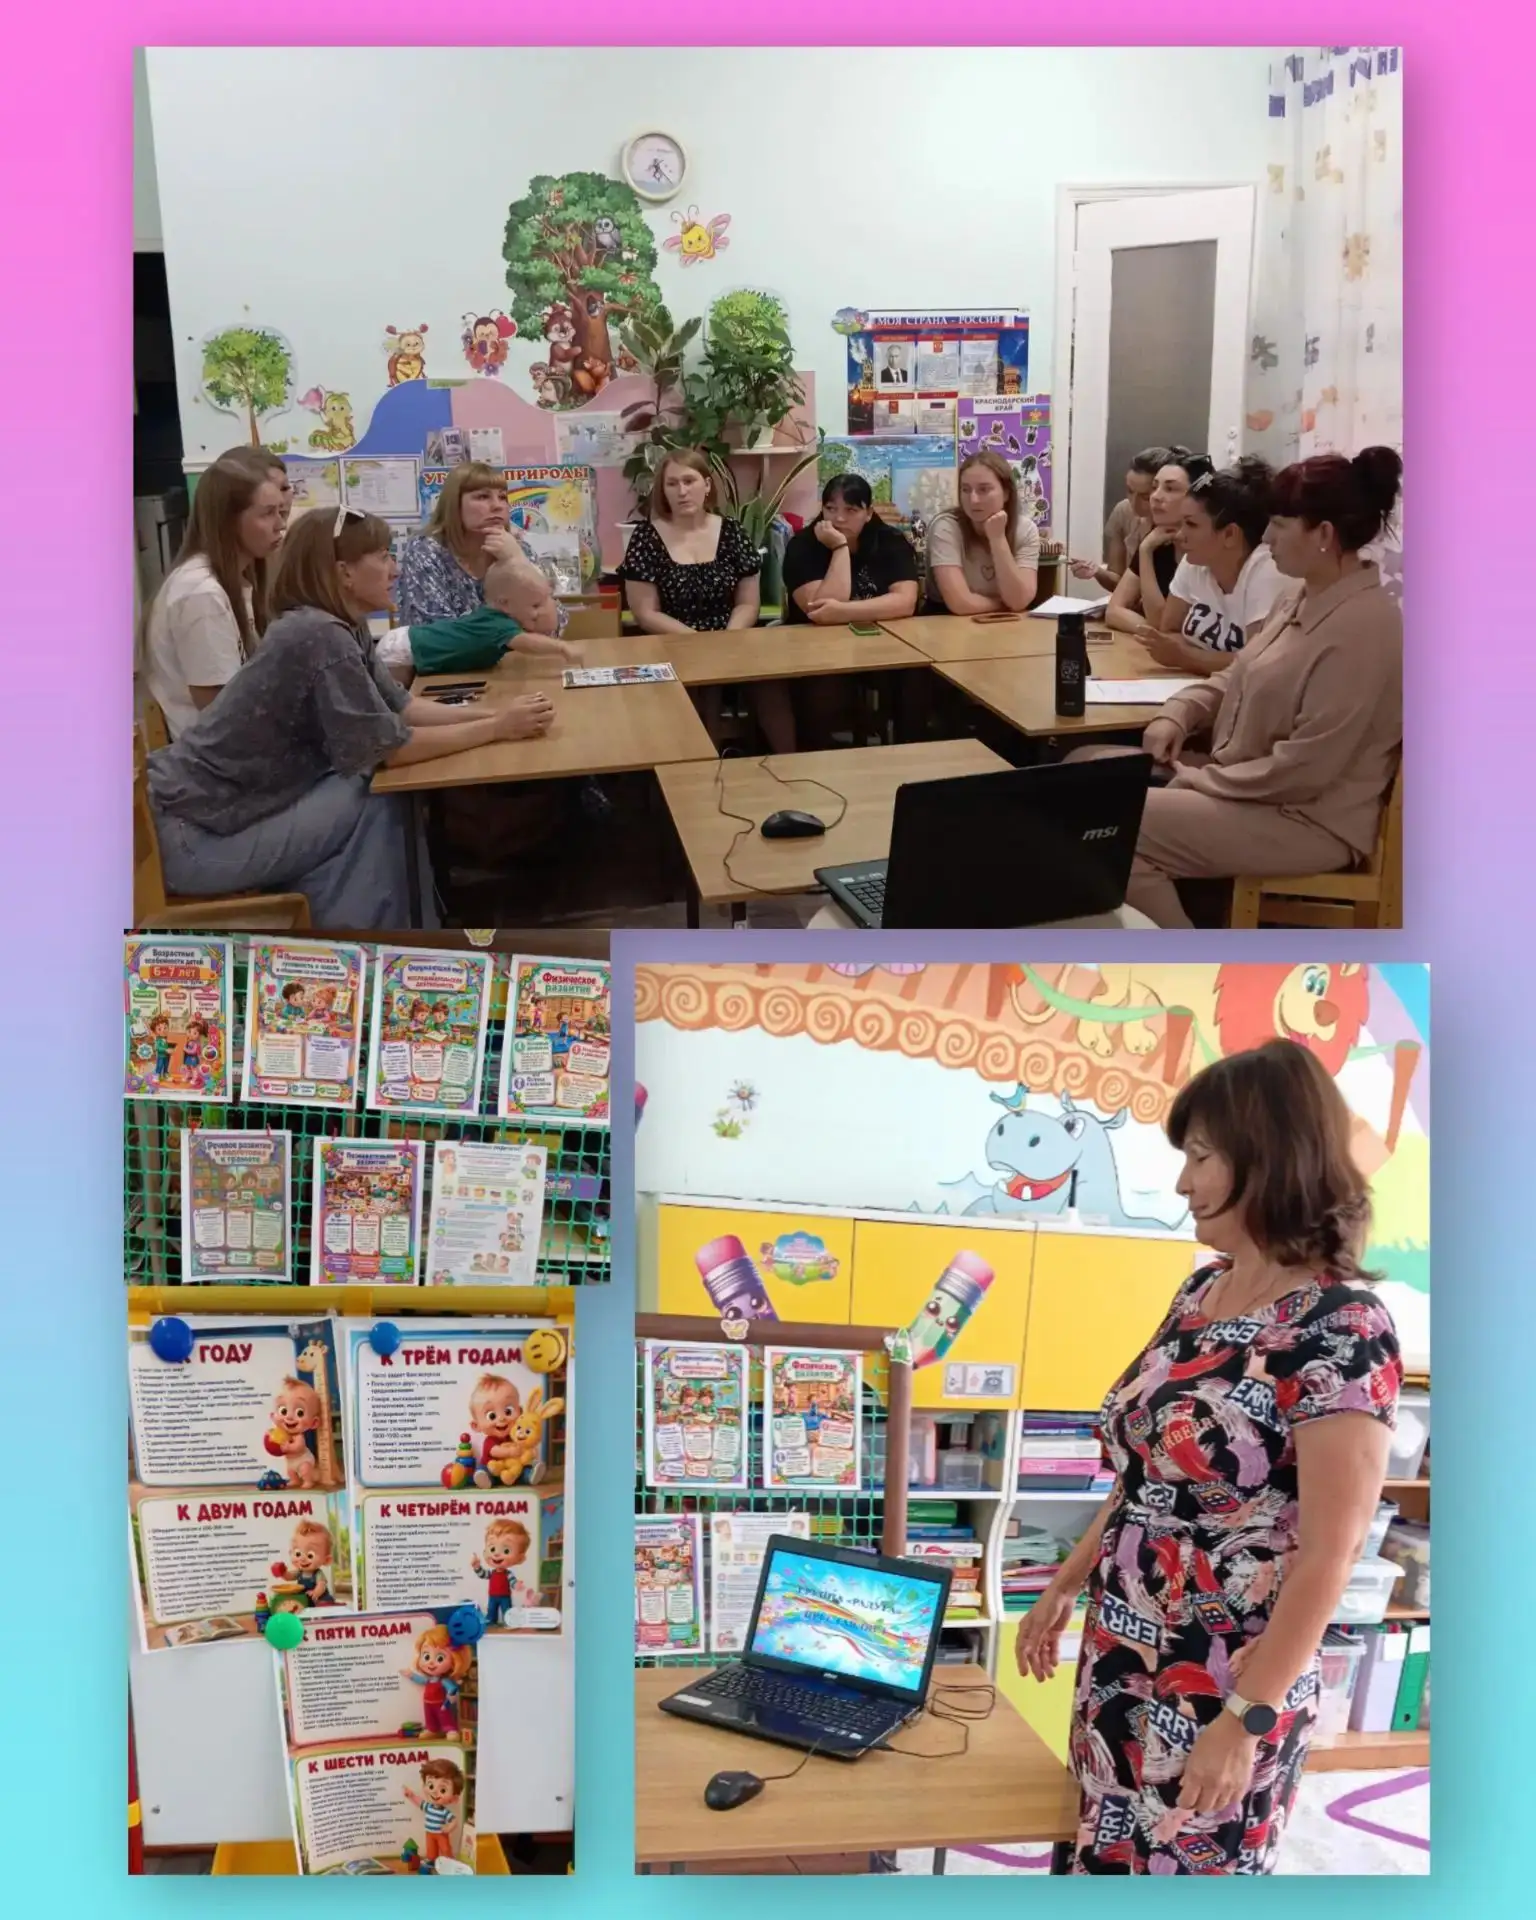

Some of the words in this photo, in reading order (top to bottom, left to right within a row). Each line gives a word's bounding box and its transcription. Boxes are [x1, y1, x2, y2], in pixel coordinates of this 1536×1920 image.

[504, 467, 588, 480] ПРИРОДЫ
[1184, 603, 1244, 652] GAP
[1082, 826, 1119, 841] msi
[542, 972, 597, 985] Физическое
[199, 1343, 253, 1364] ГОДУ
[402, 1346, 452, 1366] ТРЁМ
[458, 1348, 522, 1366] ГОДАМ
[177, 1504, 191, 1521] К
[198, 1502, 247, 1522] ДВУМ
[253, 1500, 313, 1518] ГОДАМ
[380, 1504, 391, 1518] К
[396, 1500, 470, 1518] ЧЕТЫРЁМ
[476, 1500, 528, 1514] ГОДАМ
[315, 1628, 356, 1641] ПЯТИ
[361, 1622, 412, 1637] ГОДАМ
[308, 1761, 319, 1773] К
[324, 1755, 374, 1771] ШЕСТИ
[379, 1751, 430, 1766] ГОДАМ
